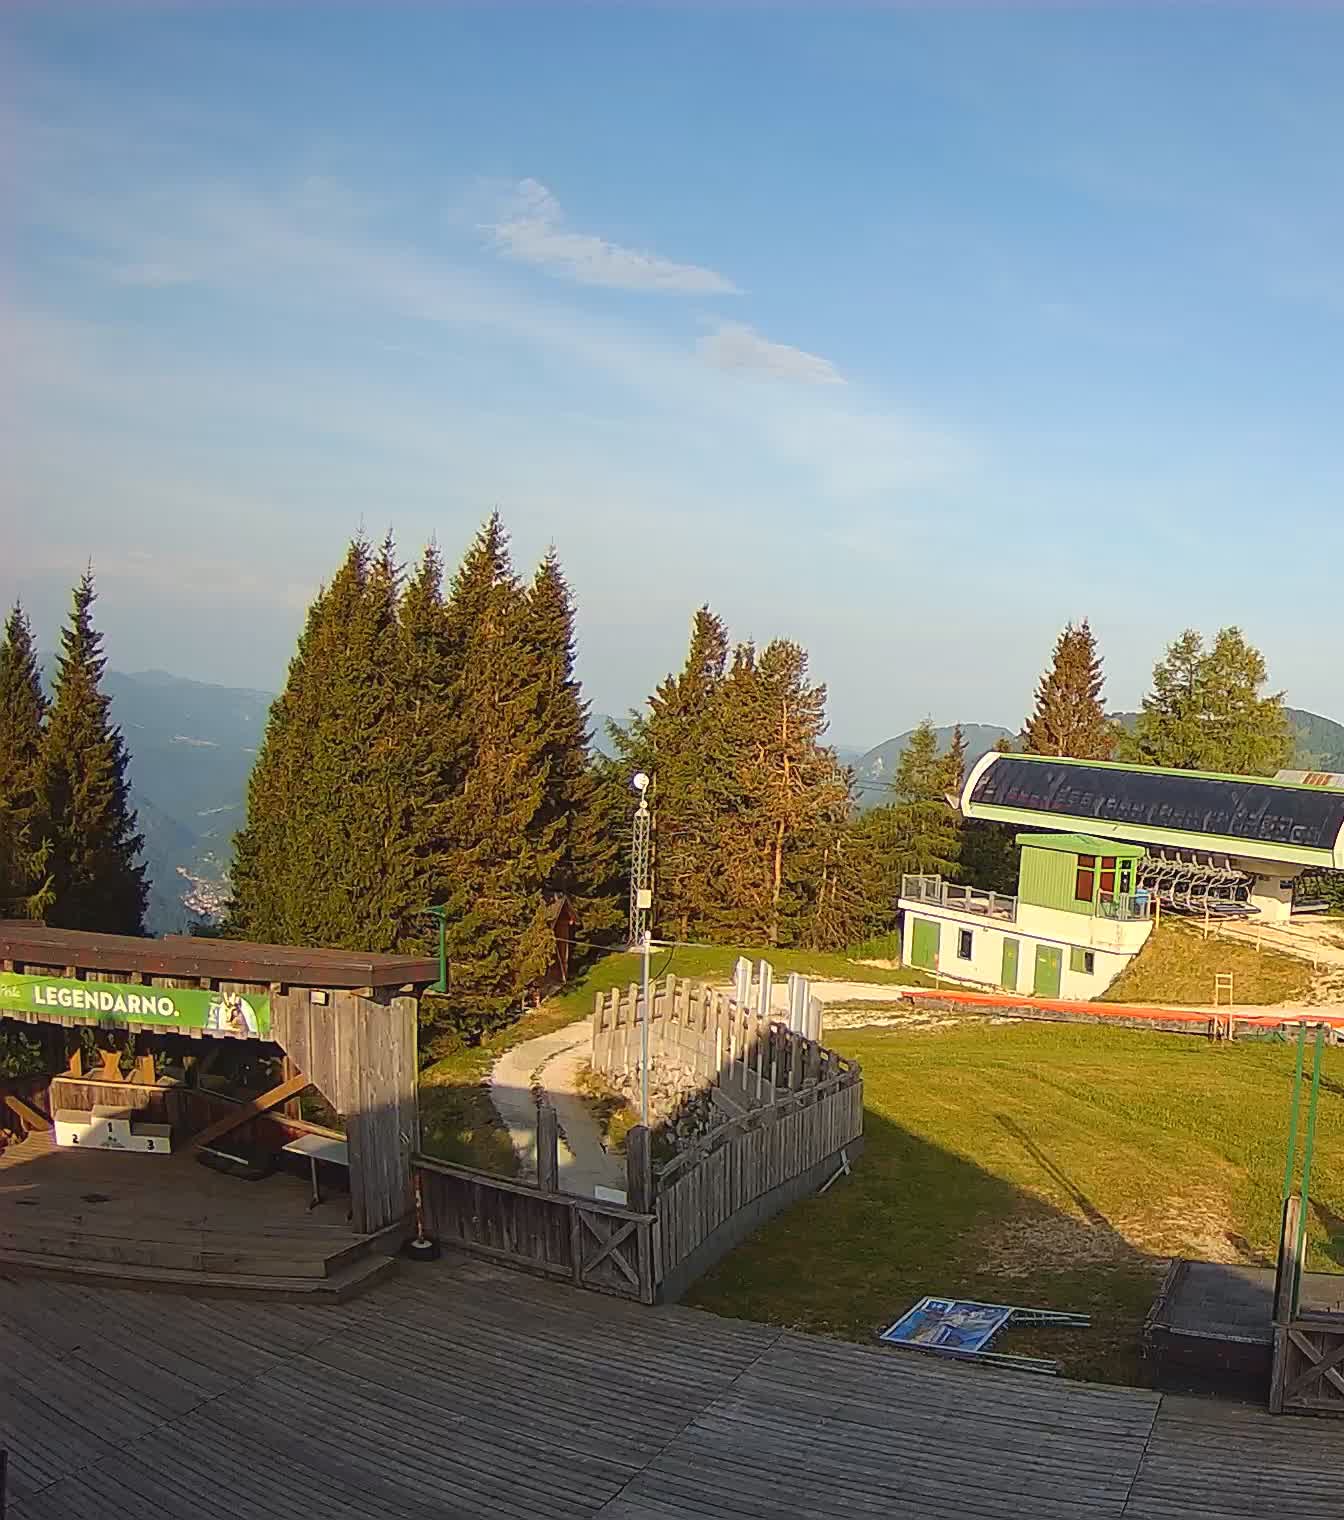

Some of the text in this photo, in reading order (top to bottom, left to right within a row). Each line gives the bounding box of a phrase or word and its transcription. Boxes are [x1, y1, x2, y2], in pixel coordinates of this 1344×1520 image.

[34, 985, 180, 1017] LEGENDARNO.
[71, 1133, 79, 1144] 2
[147, 1139, 155, 1150] 3
